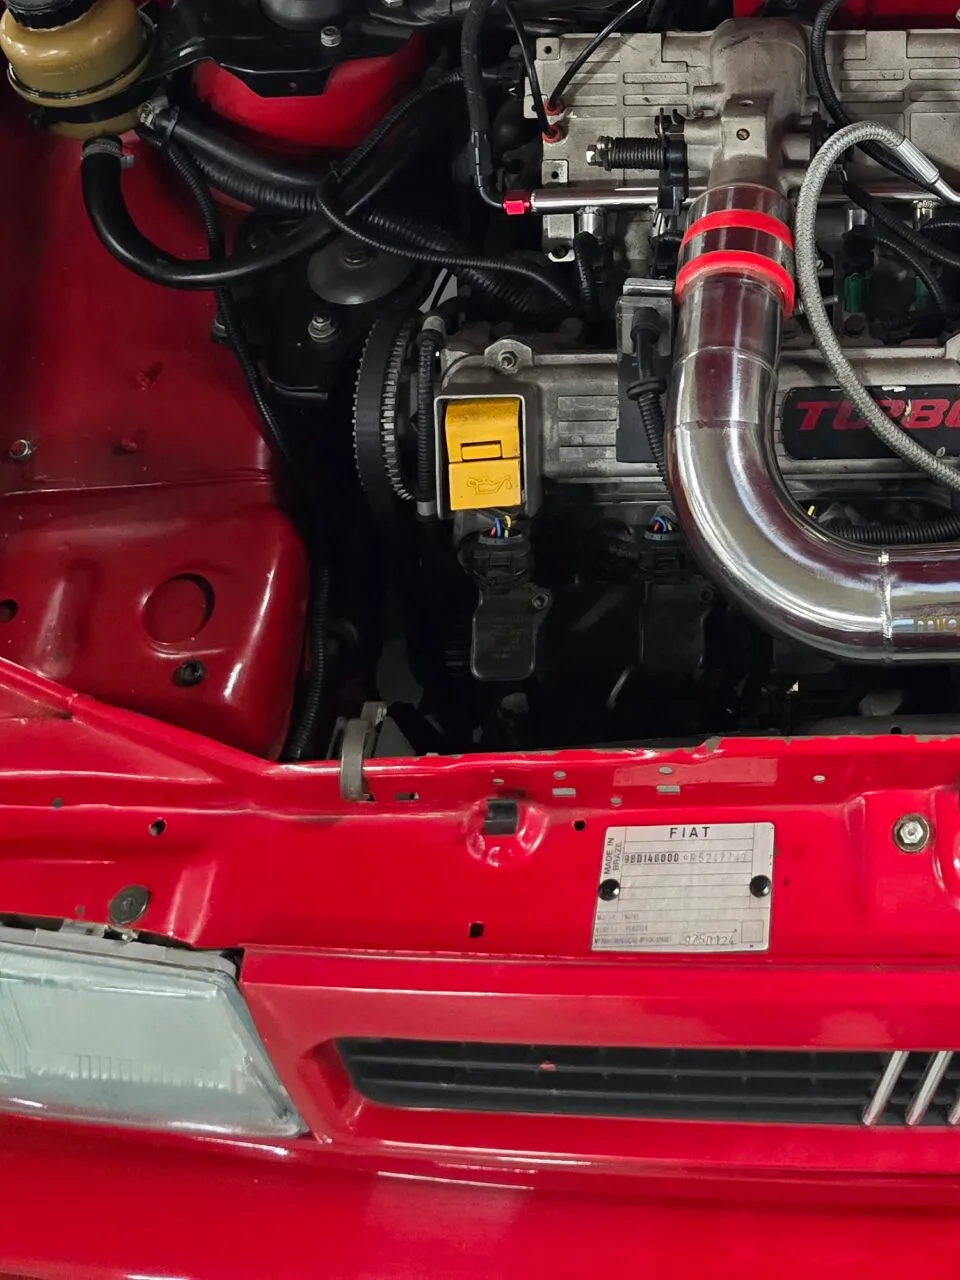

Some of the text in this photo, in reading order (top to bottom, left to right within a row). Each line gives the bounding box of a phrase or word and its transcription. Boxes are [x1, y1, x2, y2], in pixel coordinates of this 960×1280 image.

[669, 826, 711, 839] FIAT
[604, 837, 615, 875] MADE IN
